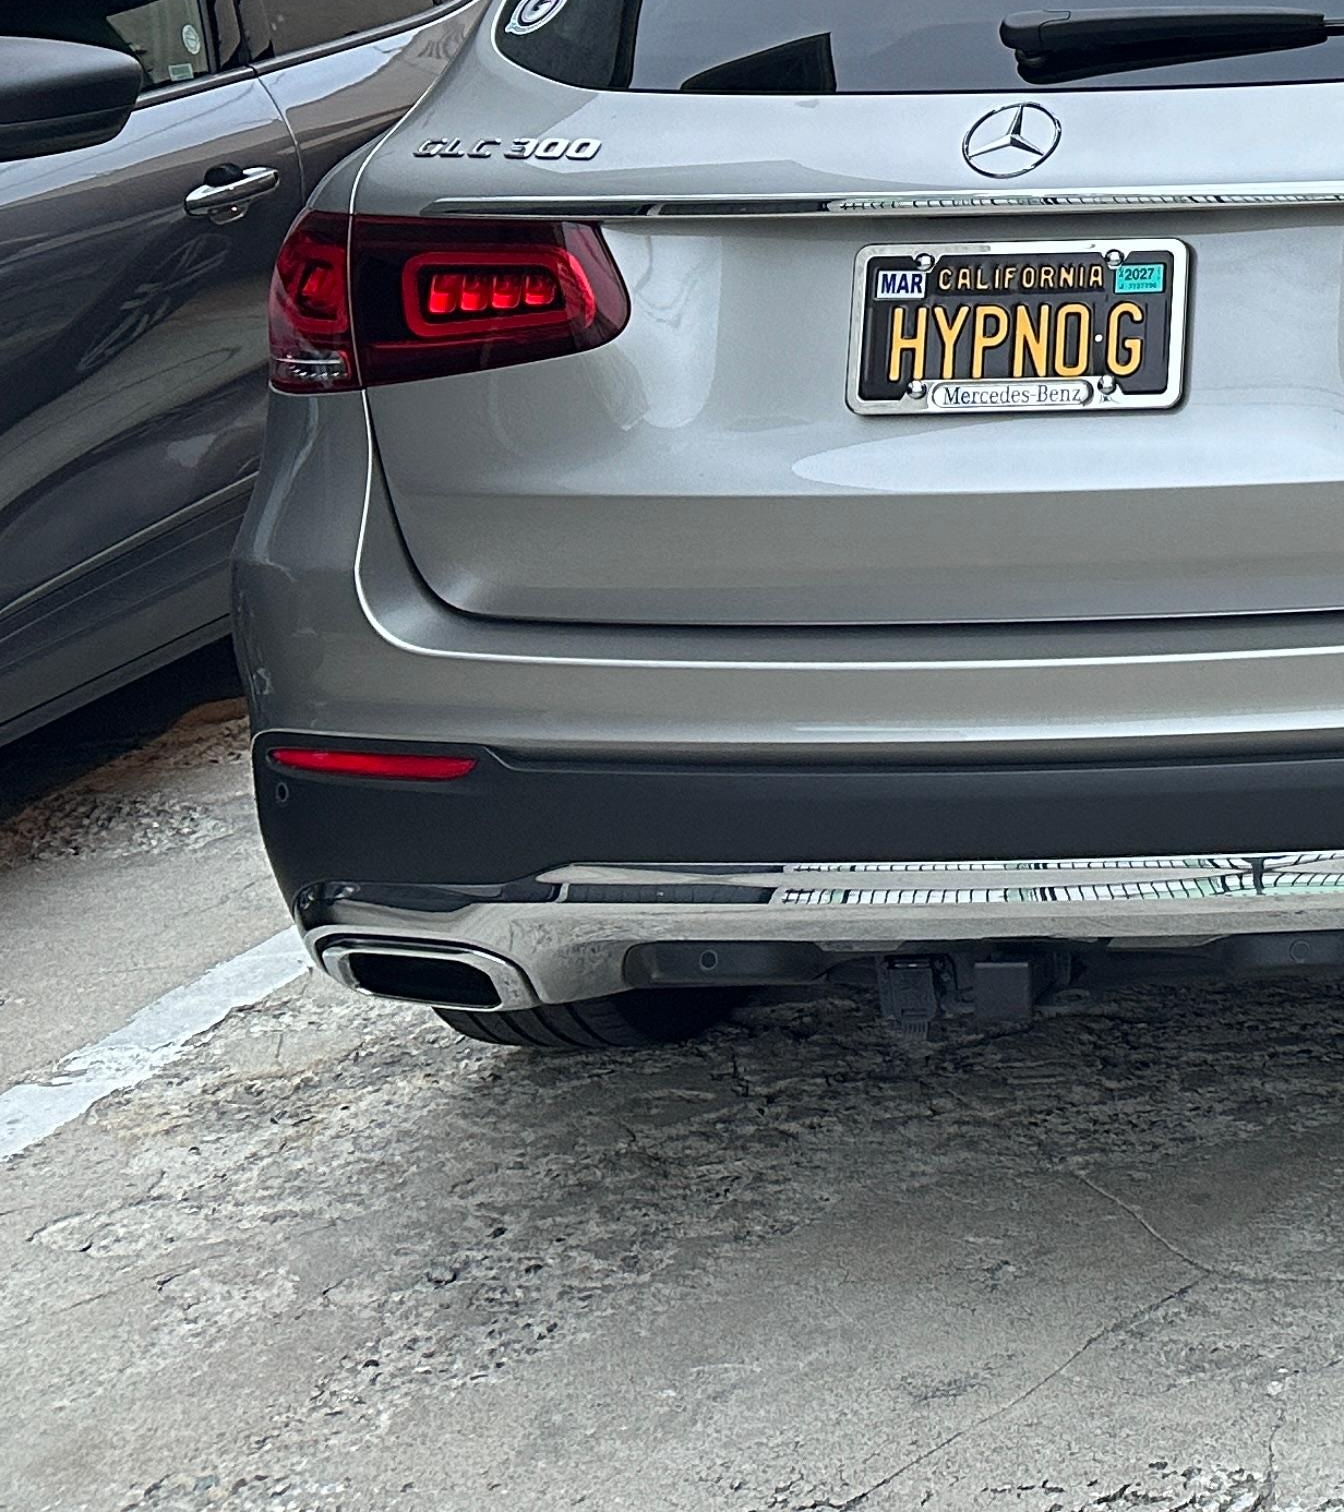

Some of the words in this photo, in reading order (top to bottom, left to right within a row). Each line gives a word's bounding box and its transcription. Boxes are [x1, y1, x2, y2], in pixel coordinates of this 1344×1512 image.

[413, 137, 501, 158] GLC
[503, 137, 602, 160] 300
[881, 272, 923, 295] MAR
[938, 265, 1104, 290] CALIFORNIA
[1124, 267, 1155, 281] 2027
[943, 384, 1082, 405] Mercedes-Benz
